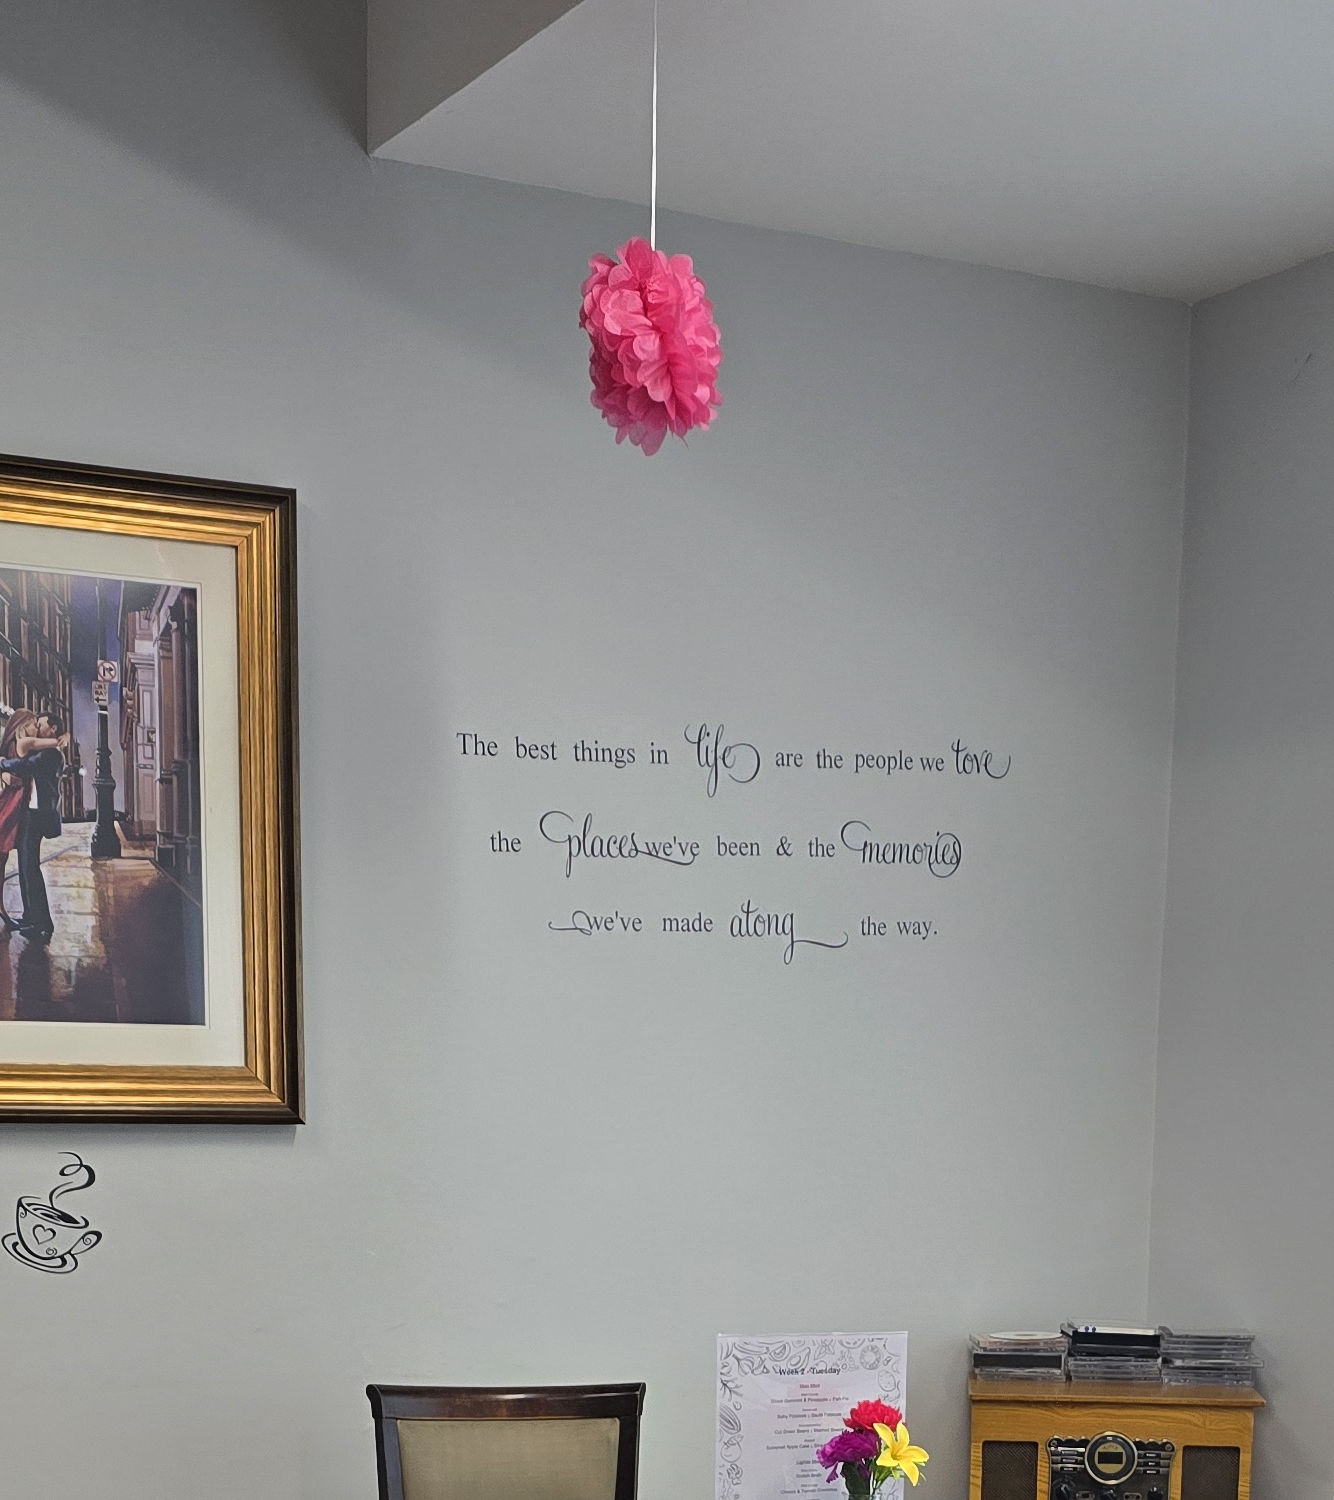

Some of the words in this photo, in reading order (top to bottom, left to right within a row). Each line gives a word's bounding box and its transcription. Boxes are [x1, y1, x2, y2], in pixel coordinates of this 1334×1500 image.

[456, 732, 498, 756] The
[515, 736, 558, 760] best
[573, 740, 636, 768] things
[650, 742, 669, 764] in
[684, 723, 761, 798] life
[775, 751, 803, 768] are
[816, 749, 844, 769] the
[854, 750, 914, 775] people
[920, 756, 945, 771] we
[490, 831, 522, 852] the
[539, 811, 695, 878] places
[645, 836, 700, 857] we've
[717, 836, 761, 857] been
[776, 836, 793, 857] &
[809, 837, 835, 857] the
[841, 820, 962, 878] memories
[548, 910, 643, 936] we've
[662, 912, 714, 932] made
[861, 916, 887, 936] the
[897, 920, 938, 940] way.
[810, 1366, 841, 1376] Tuesday
